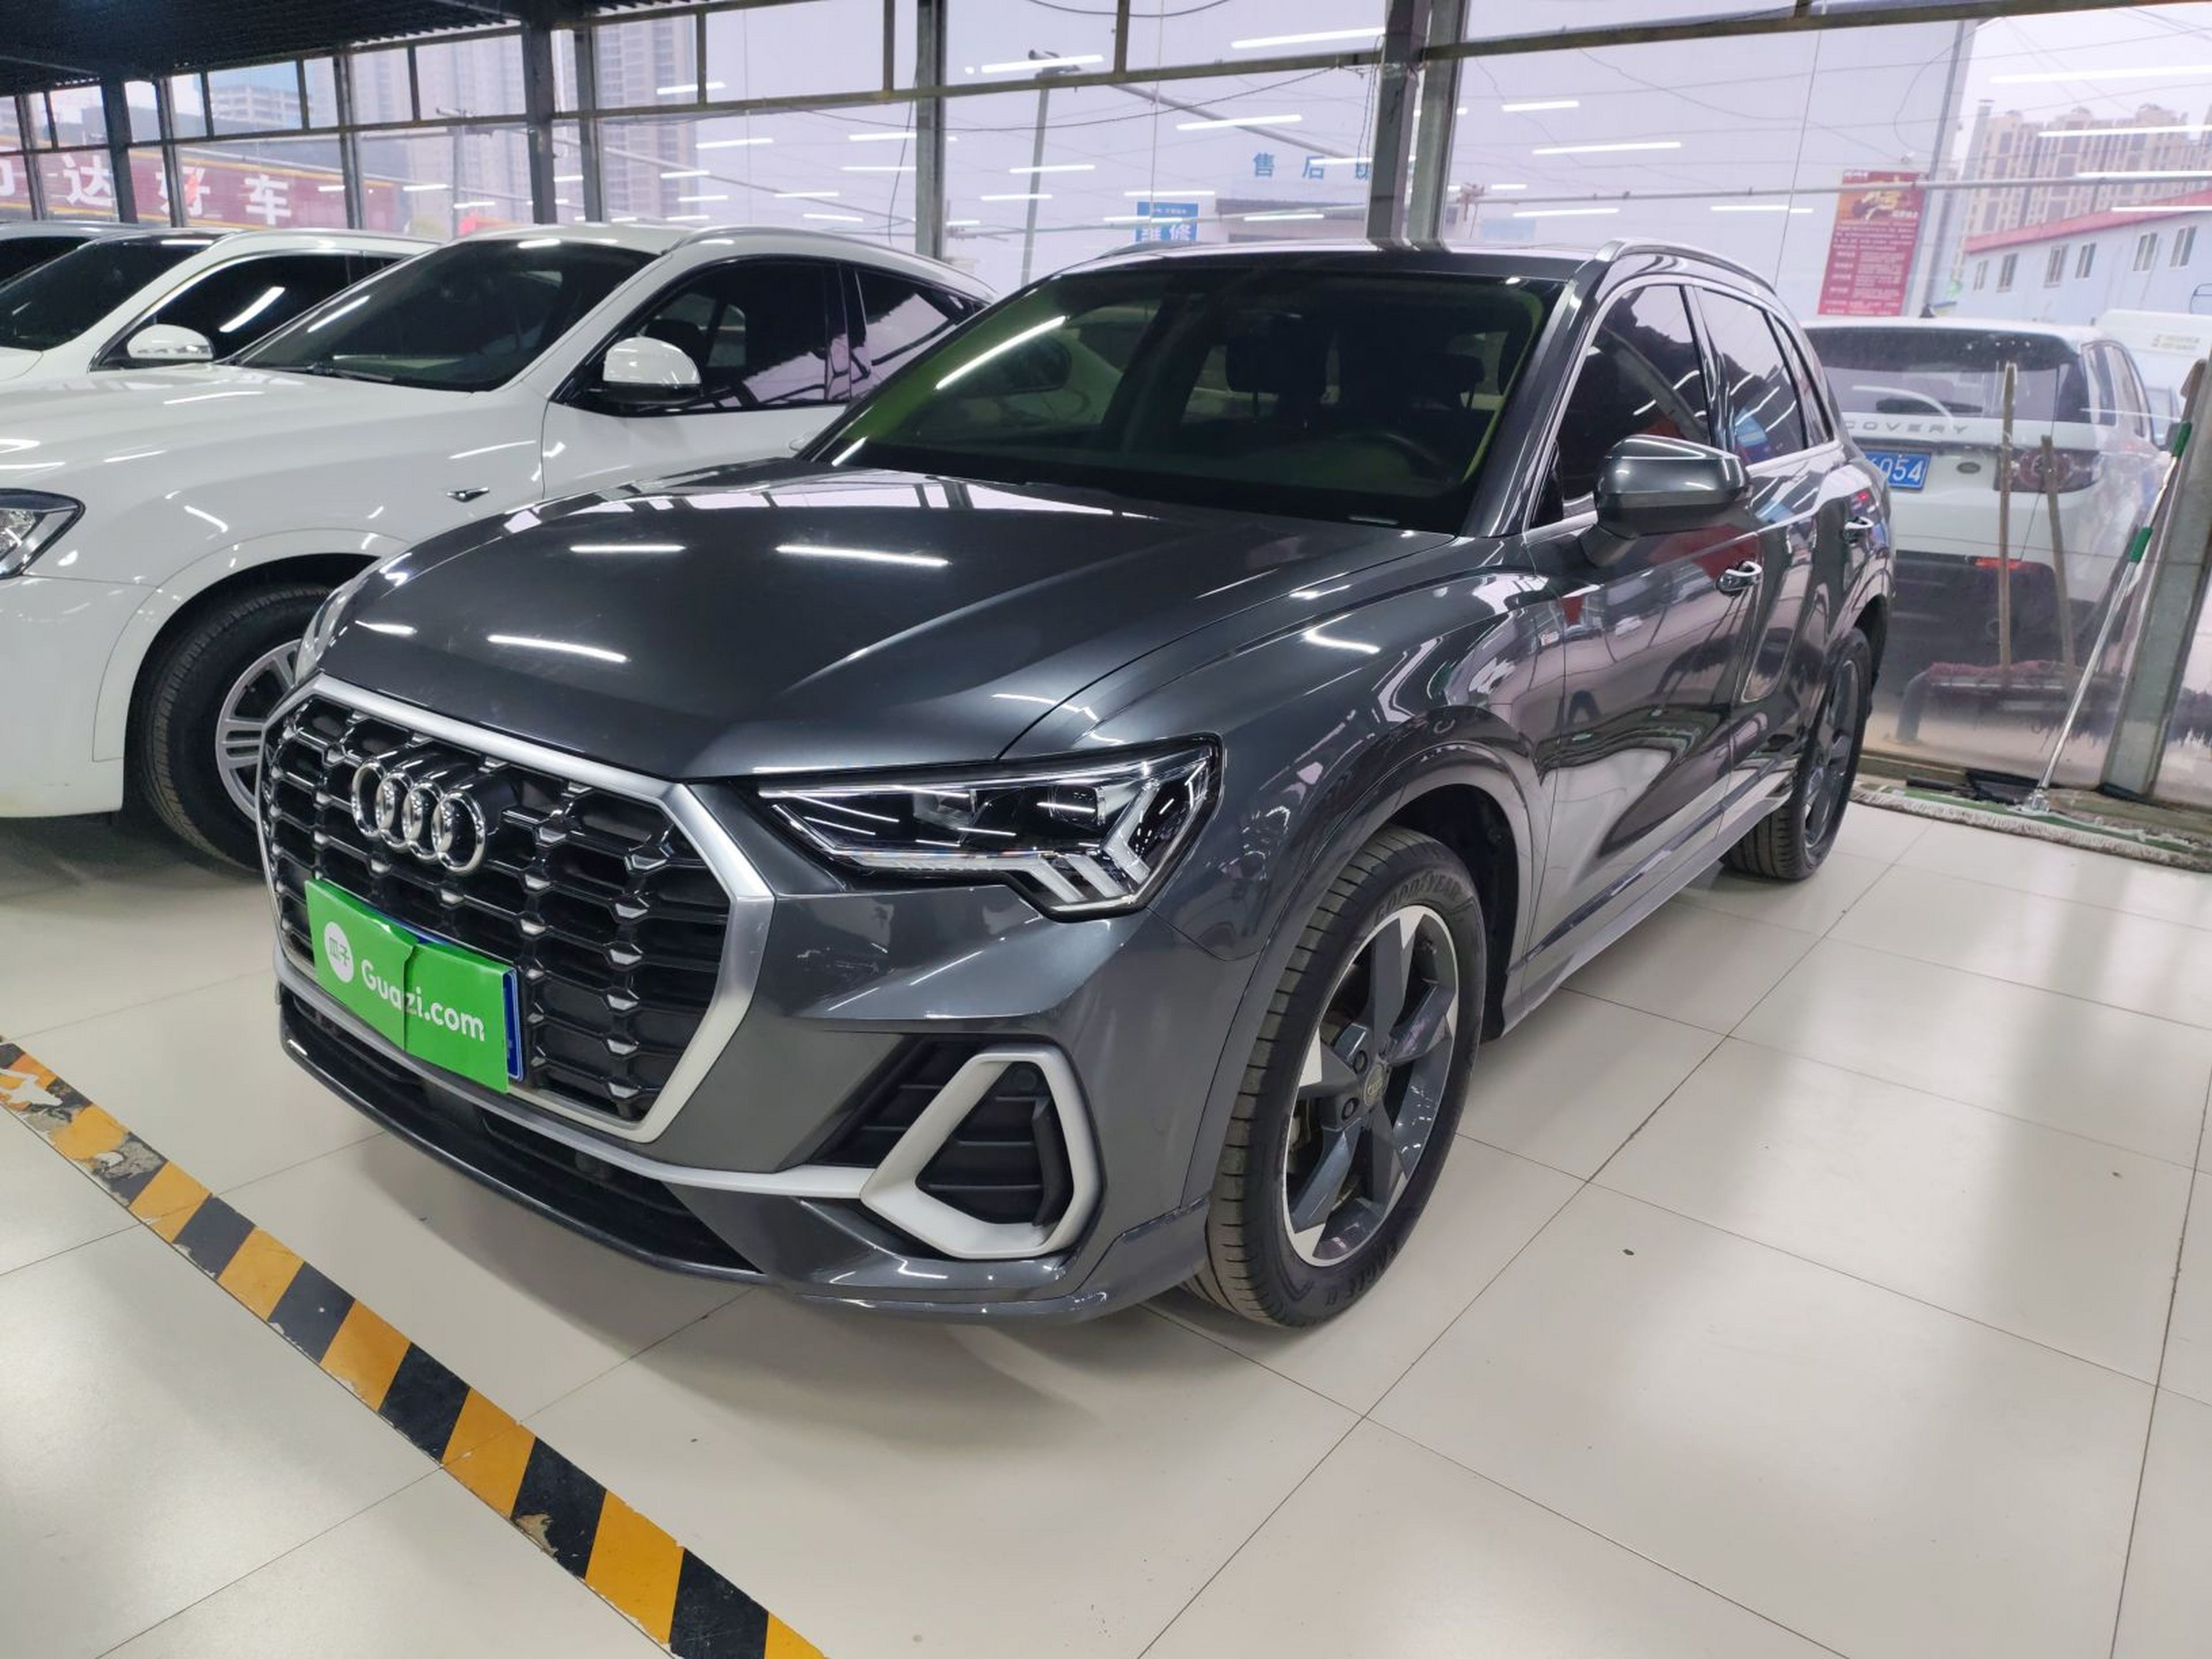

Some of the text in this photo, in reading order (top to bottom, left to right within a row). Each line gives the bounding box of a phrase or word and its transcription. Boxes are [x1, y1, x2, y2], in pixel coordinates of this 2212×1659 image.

[0, 152, 291, 226] 达好车
[1872, 457, 1925, 483] 054
[362, 959, 484, 1041] Guazi.com
